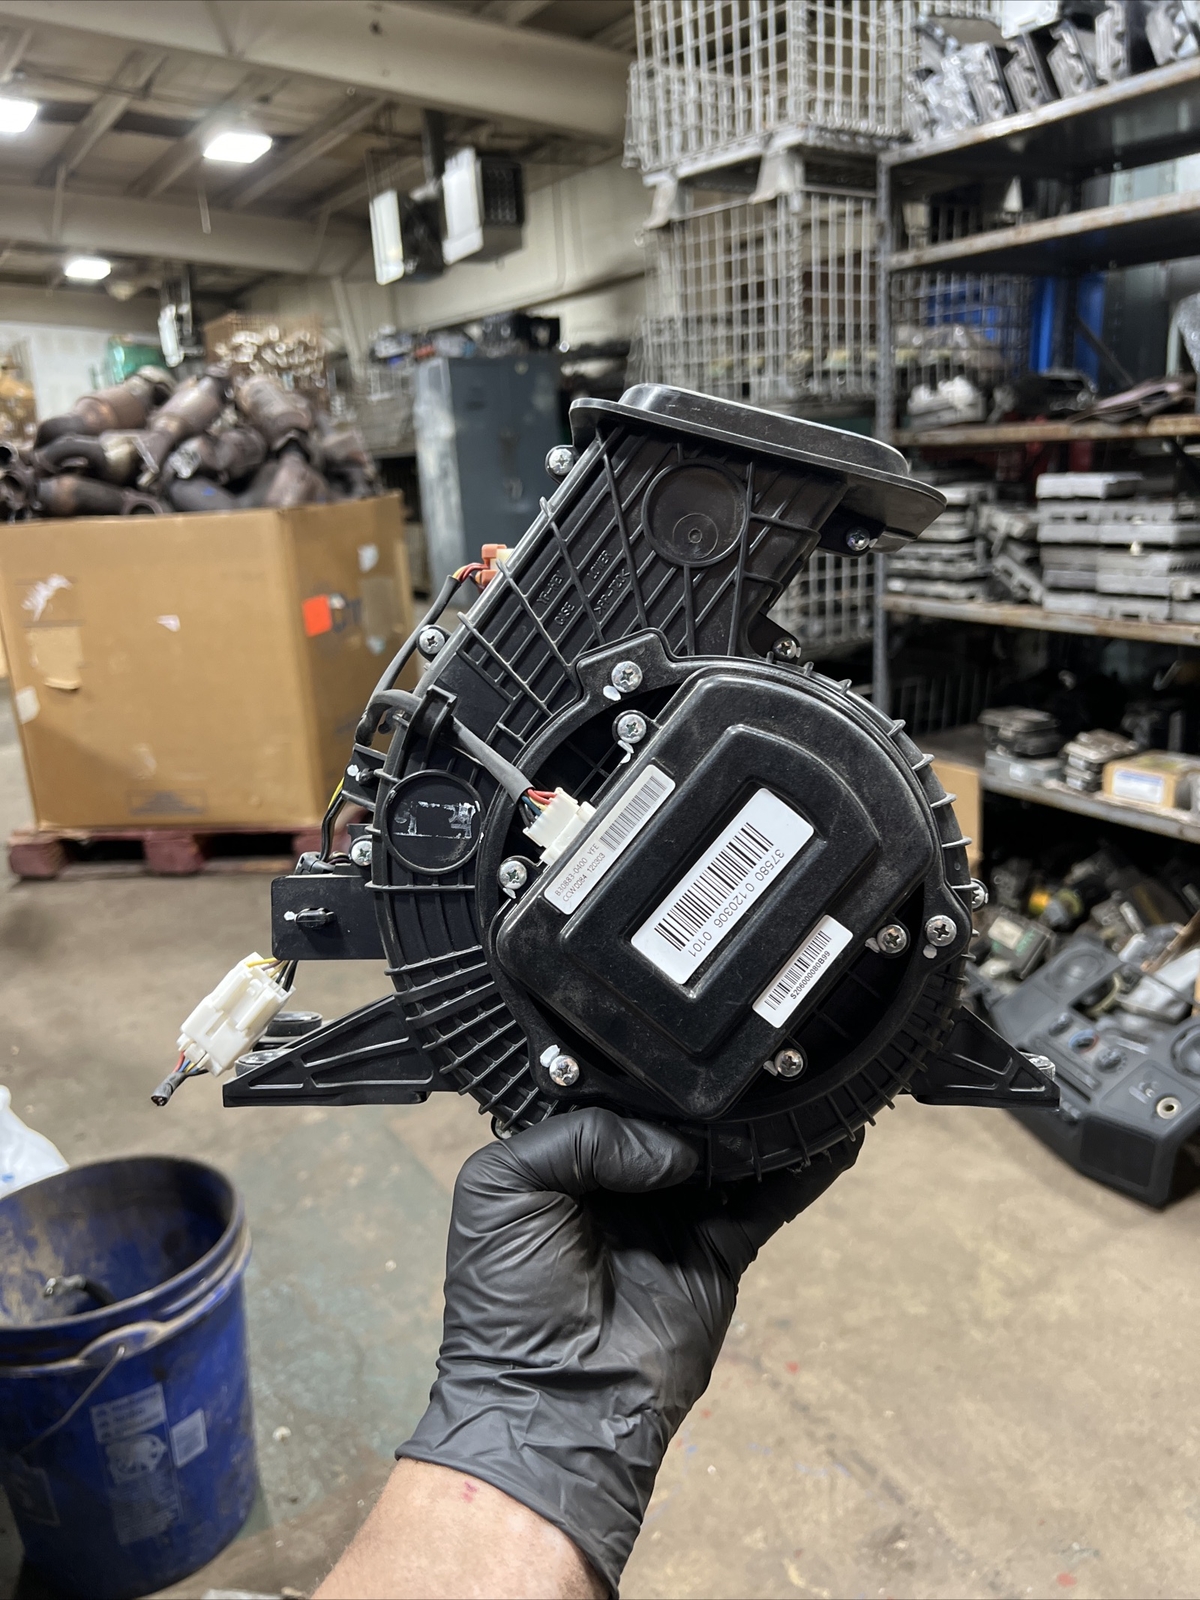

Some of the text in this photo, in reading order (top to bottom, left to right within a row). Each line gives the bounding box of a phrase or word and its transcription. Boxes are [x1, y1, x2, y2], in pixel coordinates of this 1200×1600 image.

[586, 549, 613, 579] LOWER
[587, 843, 600, 856] YFE
[587, 852, 606, 873] 120303
[754, 848, 785, 882] 37580
[687, 931, 712, 958] 0101
